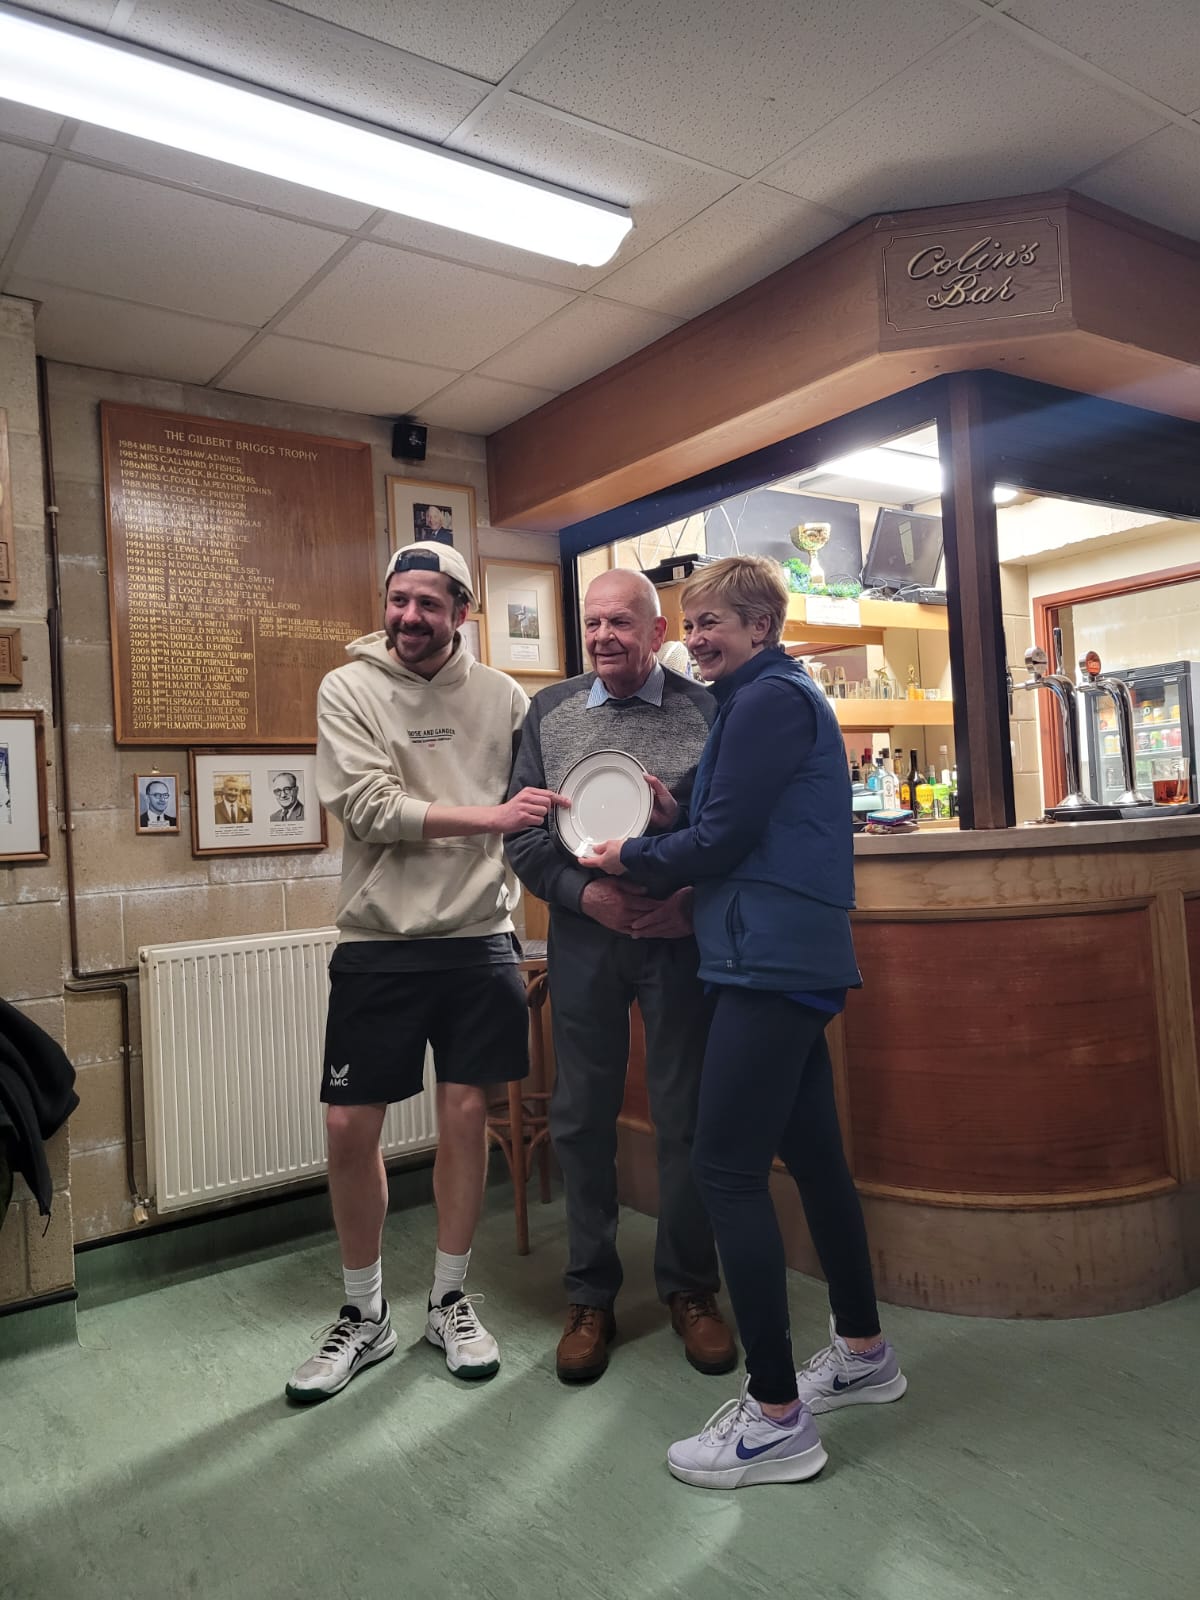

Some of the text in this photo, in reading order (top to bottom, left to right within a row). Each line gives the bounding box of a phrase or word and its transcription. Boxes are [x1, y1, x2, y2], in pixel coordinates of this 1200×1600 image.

[907, 237, 1040, 280] Colin's
[927, 272, 1016, 309] Bar
[165, 430, 318, 461] THE GILBERT BRIGGS TROPHY
[146, 542, 165, 551] MISS
[147, 551, 166, 559] MISS
[330, 1078, 349, 1087] AMC
